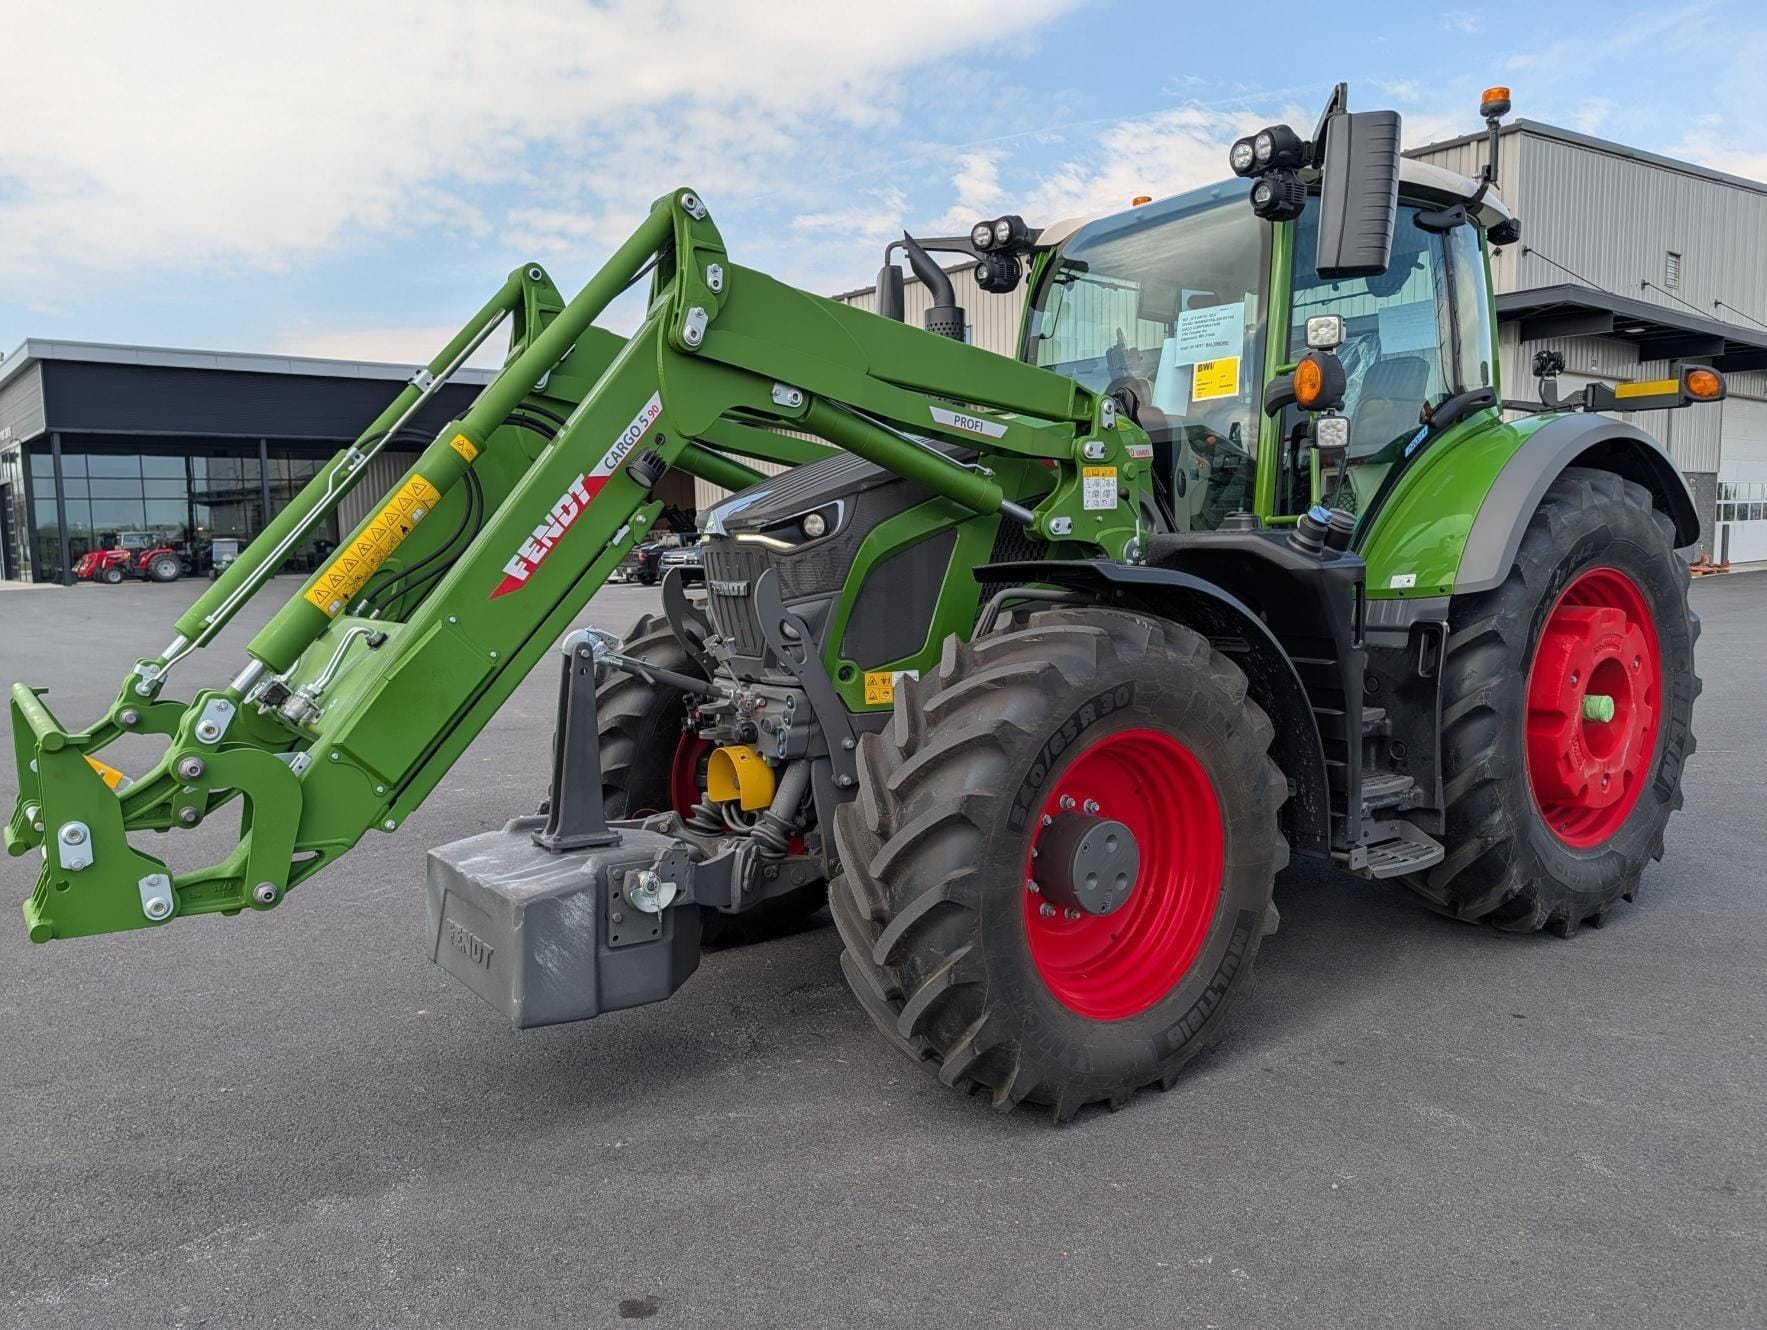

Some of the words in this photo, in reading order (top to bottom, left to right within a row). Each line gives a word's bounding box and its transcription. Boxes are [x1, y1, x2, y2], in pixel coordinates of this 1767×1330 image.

[604, 425, 642, 470] CARGO
[638, 415, 649, 428] 5
[647, 404, 660, 418] 90
[953, 415, 983, 432] PROFI
[502, 472, 591, 581] FENDT
[446, 917, 495, 970] FENDT
